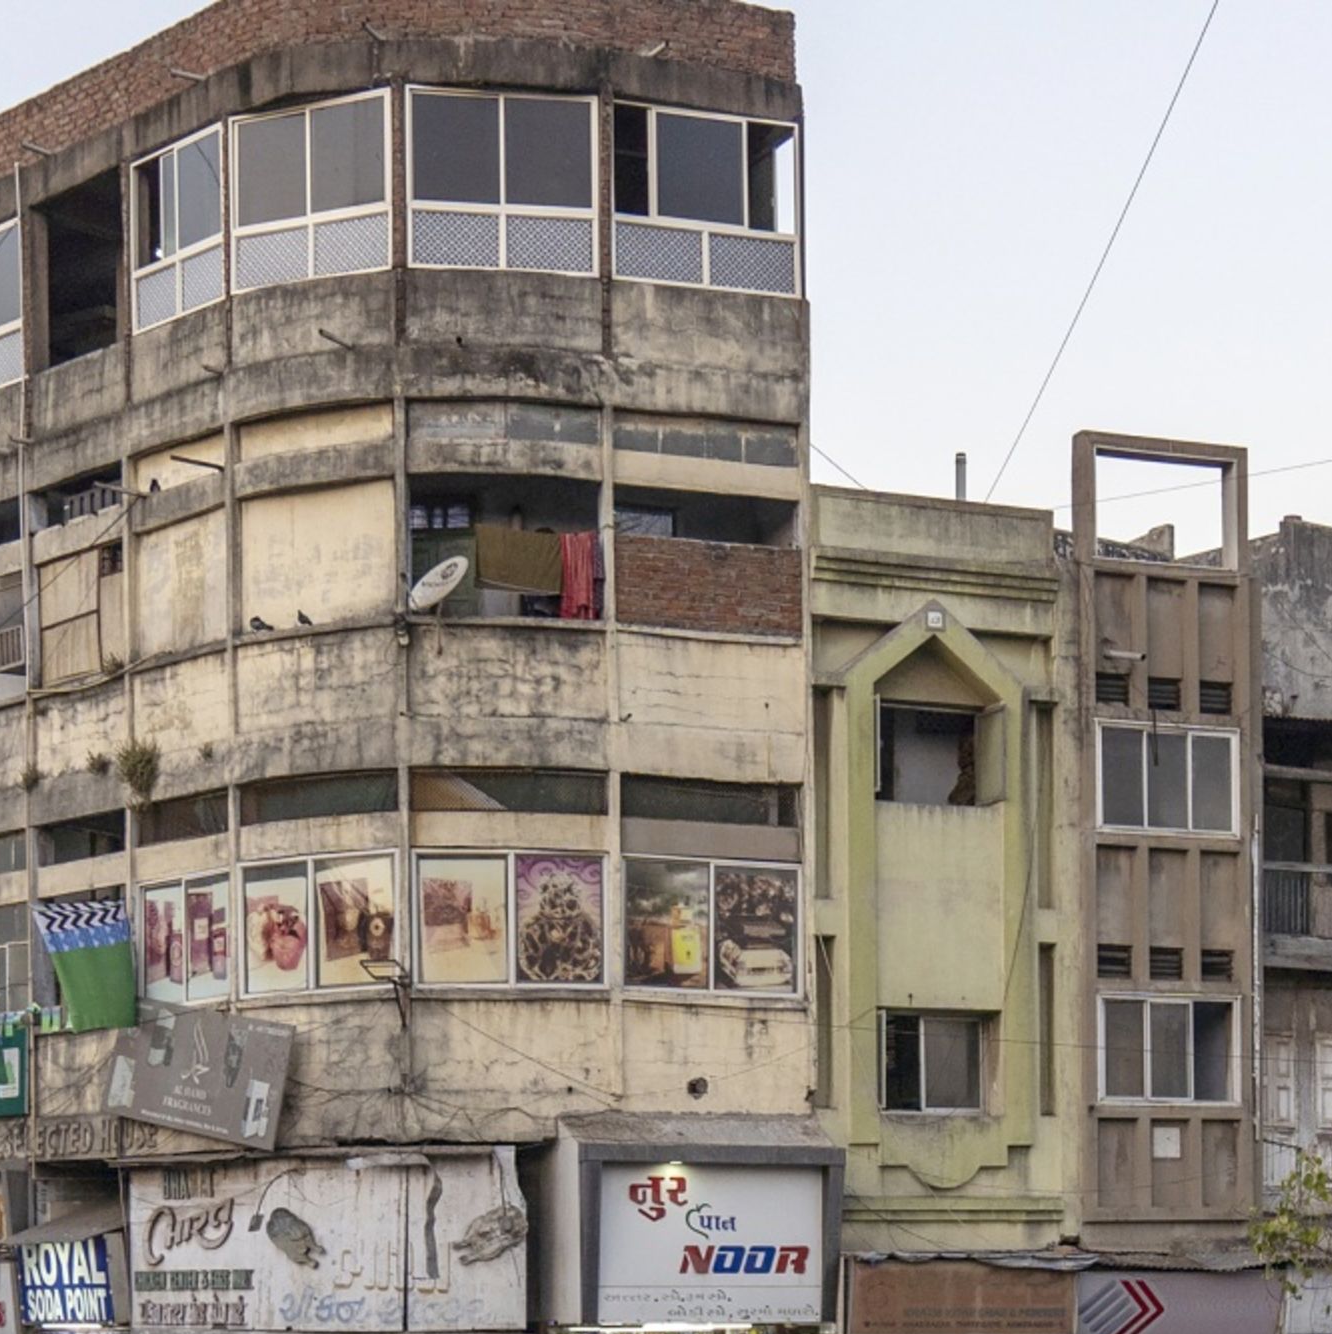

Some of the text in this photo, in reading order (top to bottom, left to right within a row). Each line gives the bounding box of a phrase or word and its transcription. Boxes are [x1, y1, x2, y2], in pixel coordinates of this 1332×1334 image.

[23, 1236, 106, 1287] ROYAL
[679, 1245, 810, 1274] NOOR
[27, 1289, 63, 1322] SODA
[66, 1287, 108, 1321] POINT
